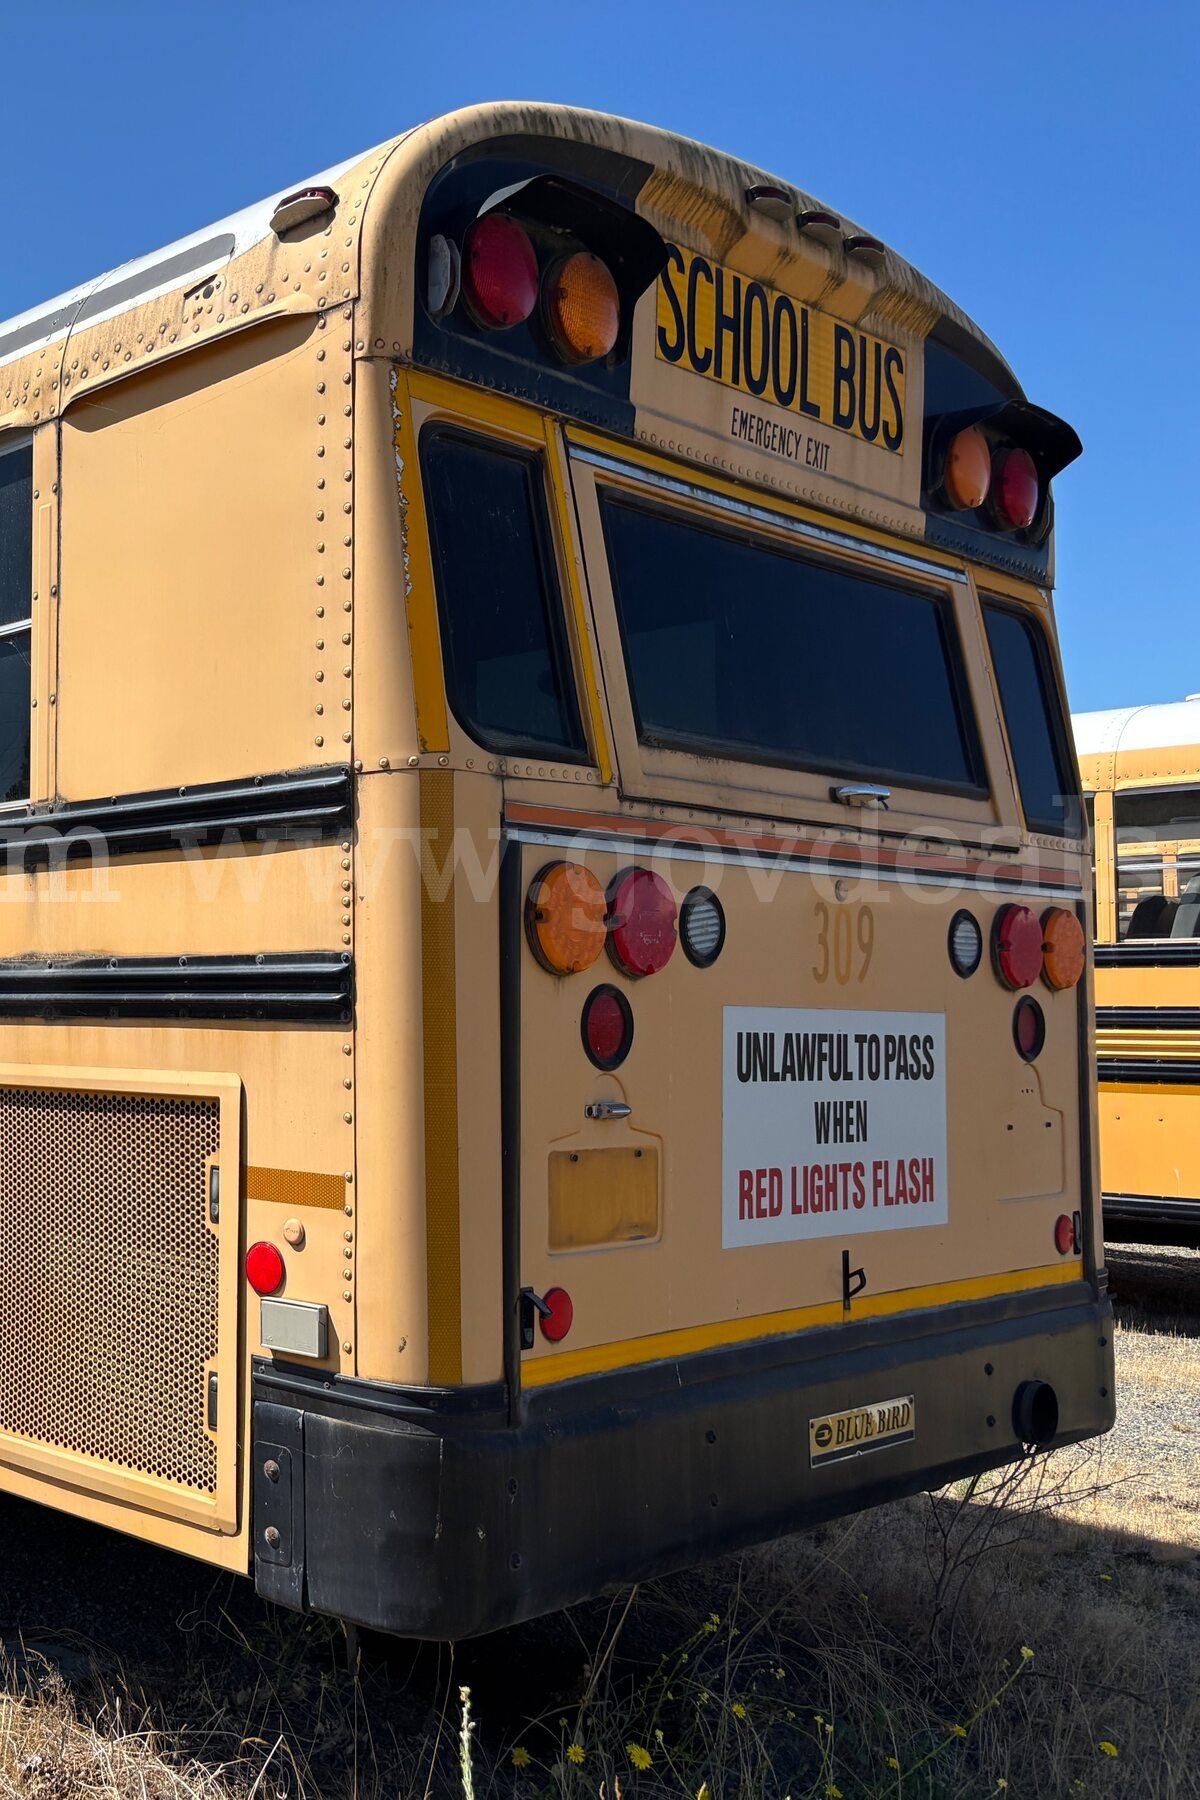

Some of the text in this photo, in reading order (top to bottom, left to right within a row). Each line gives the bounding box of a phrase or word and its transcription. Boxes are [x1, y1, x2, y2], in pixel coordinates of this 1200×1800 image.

[657, 243, 904, 451] SCHOOL BUS
[731, 407, 830, 472] EMERGENCY EXIT
[812, 902, 874, 986] 309
[736, 1032, 935, 1083] UNLAWFUL TO PASS
[814, 1100, 868, 1144] WHEN
[738, 1157, 934, 1220] RED LIGHTS FLASH
[835, 1402, 911, 1445] BLUE BIRD
